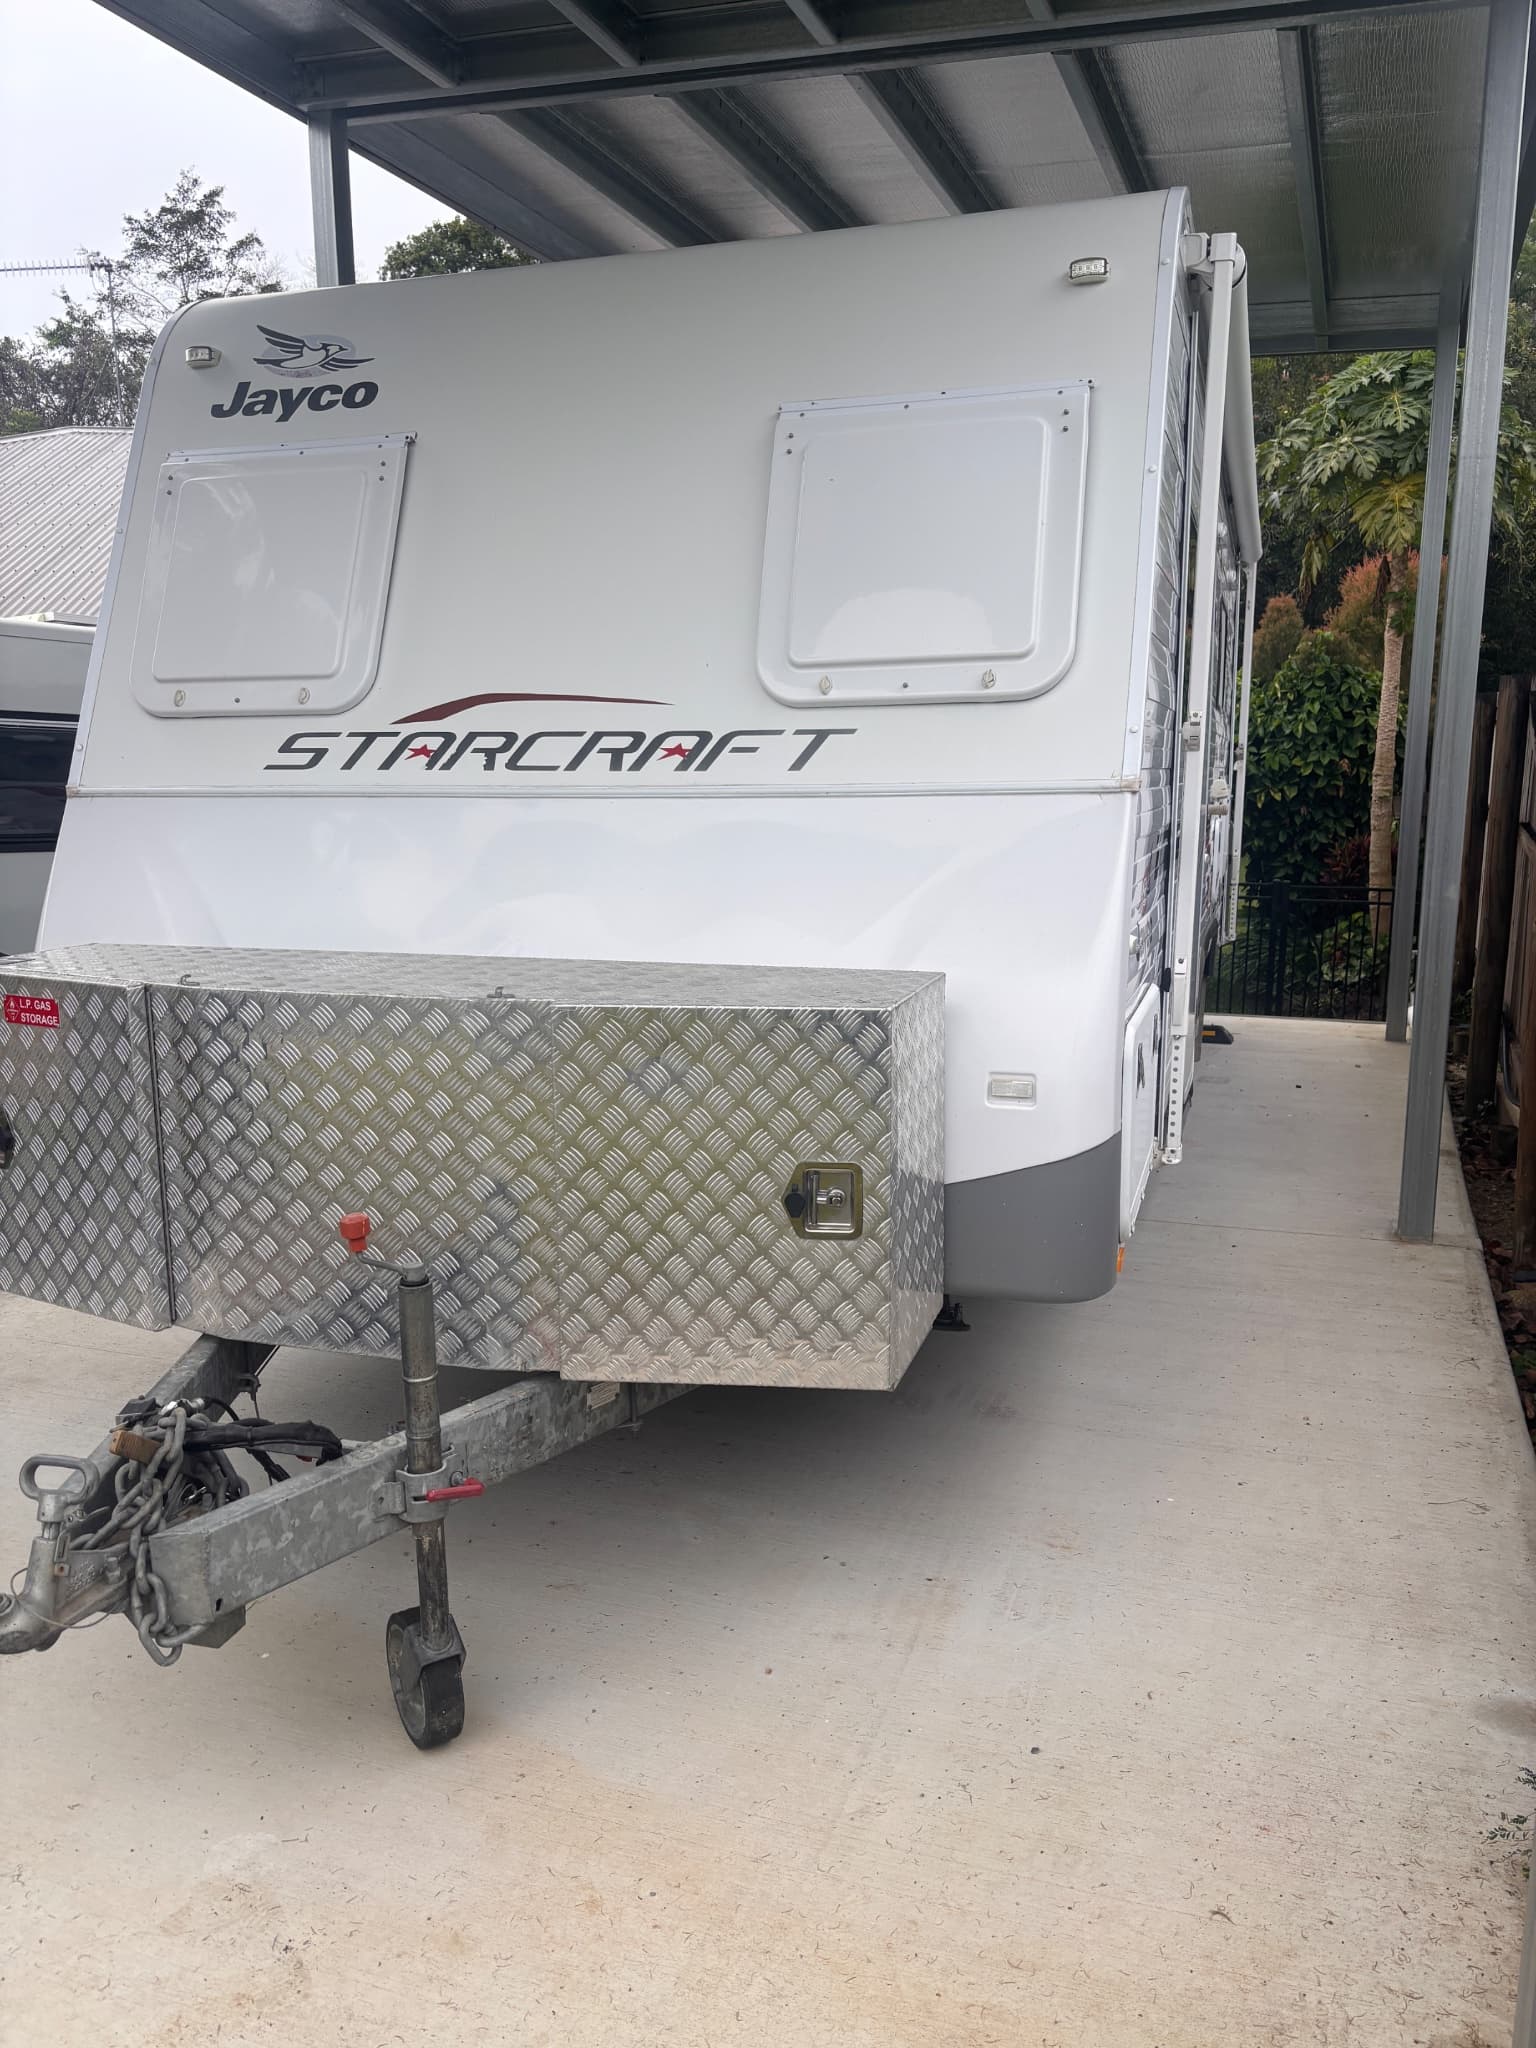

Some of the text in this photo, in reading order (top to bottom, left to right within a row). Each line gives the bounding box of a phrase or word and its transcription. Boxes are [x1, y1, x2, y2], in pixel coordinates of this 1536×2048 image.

[211, 381, 378, 422] Jayco
[264, 729, 856, 771] STARCRAFT
[20, 1012, 59, 1026] STORAGE
[34, 1000, 51, 1011] GAS
